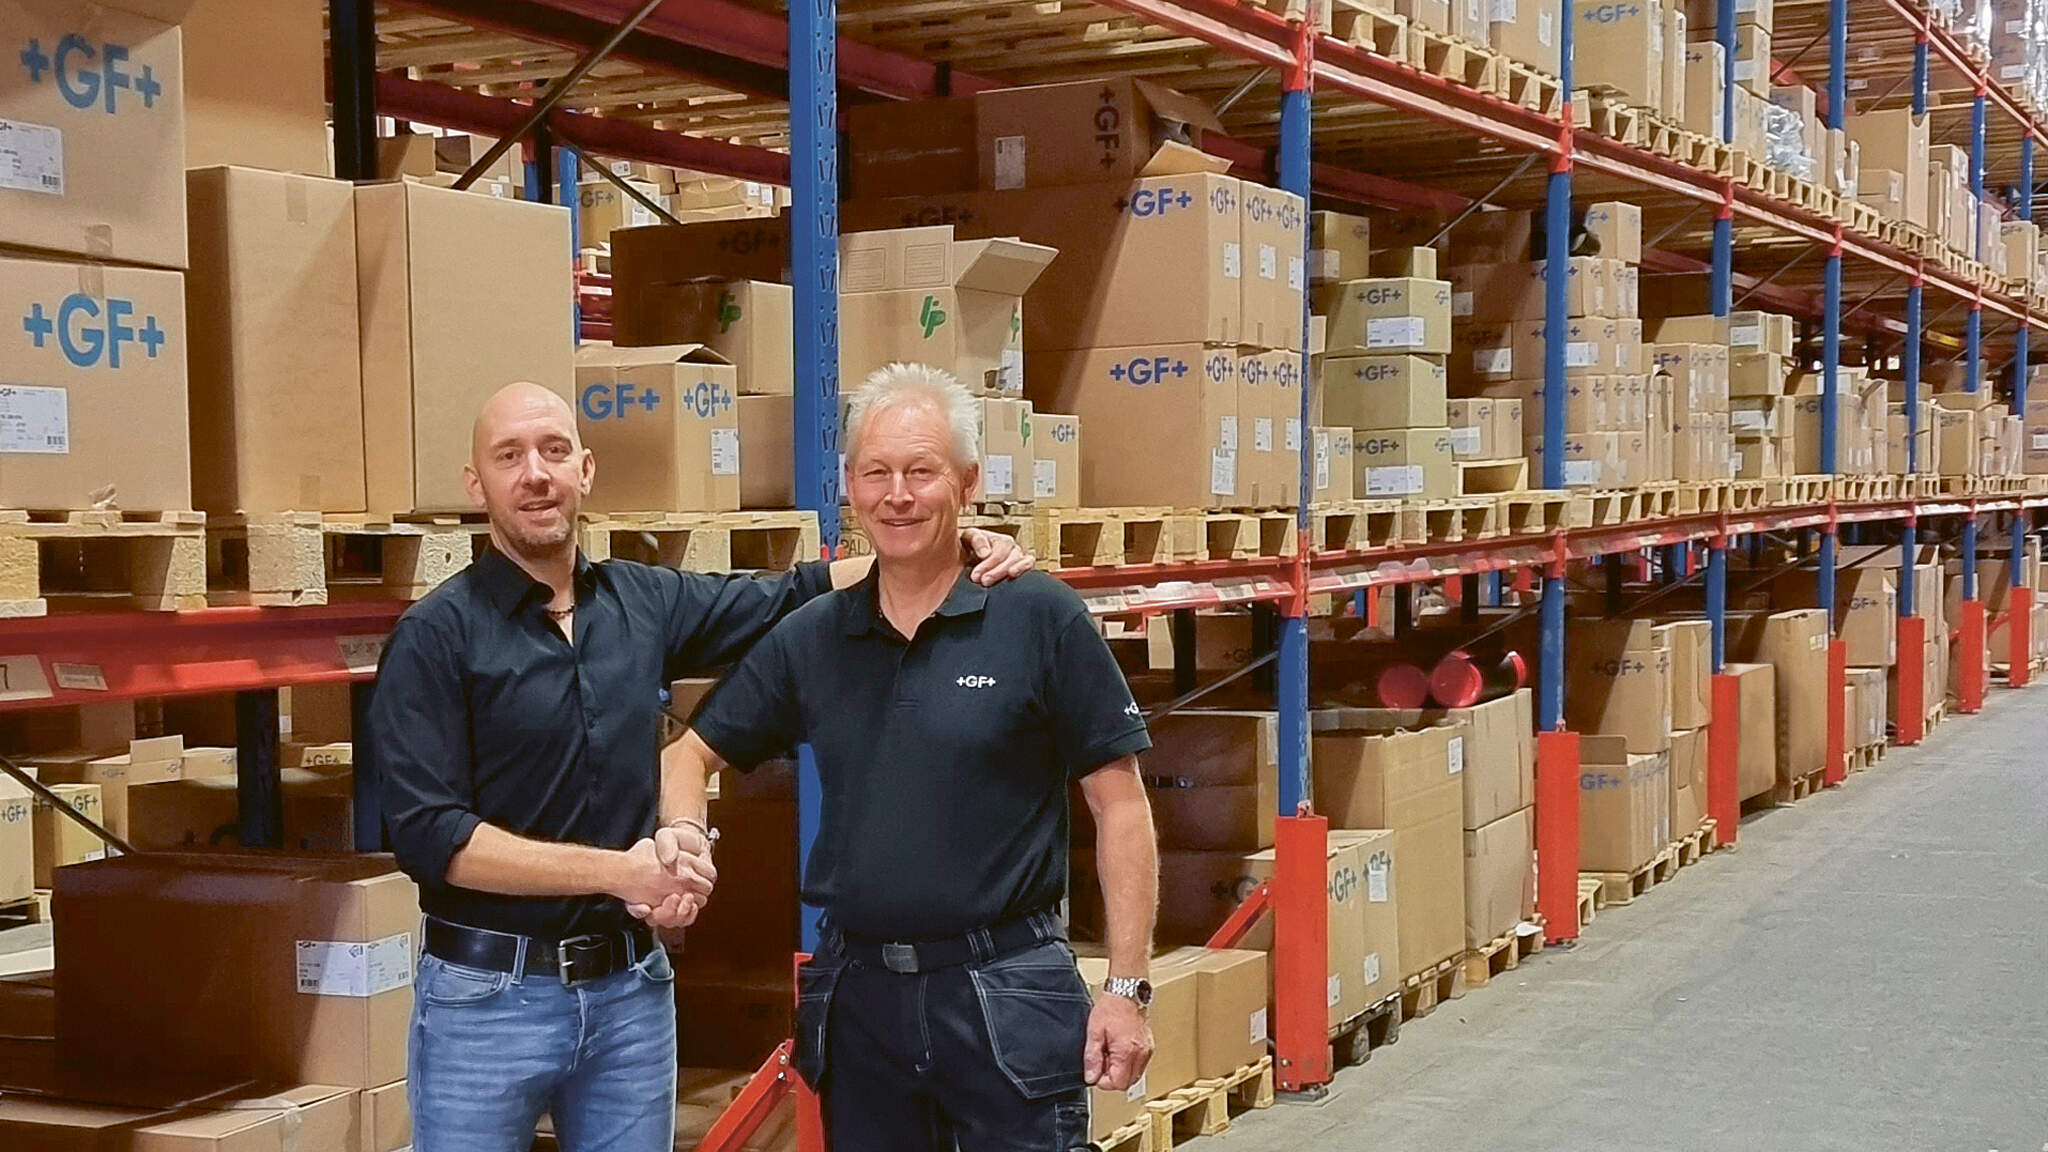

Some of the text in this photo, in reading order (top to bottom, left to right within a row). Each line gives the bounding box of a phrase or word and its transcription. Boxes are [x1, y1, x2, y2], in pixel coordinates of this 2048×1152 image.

[1583, 4, 1639, 23] +GF+
[20, 33, 162, 115] +GF+
[1094, 86, 1121, 169] +GF+
[580, 191, 614, 208] GF+
[1113, 187, 1193, 217] +GF+
[1210, 187, 1237, 214] +GF+
[1246, 196, 1273, 222] +GF+
[1356, 287, 1402, 305] +GF+
[23, 293, 165, 369] +GF+
[1109, 357, 1189, 385] +GF+
[1206, 355, 1234, 382] +GF+
[1240, 359, 1268, 385] +GF+
[1273, 362, 1298, 388] +GF+
[1354, 365, 1399, 381] +GF+
[577, 383, 661, 420] GF+
[683, 382, 732, 418] +GF+
[1051, 423, 1076, 442] +GF+
[1355, 439, 1400, 455] +GF+
[956, 675, 997, 689] +GF+
[1580, 773, 1621, 791] GF+
